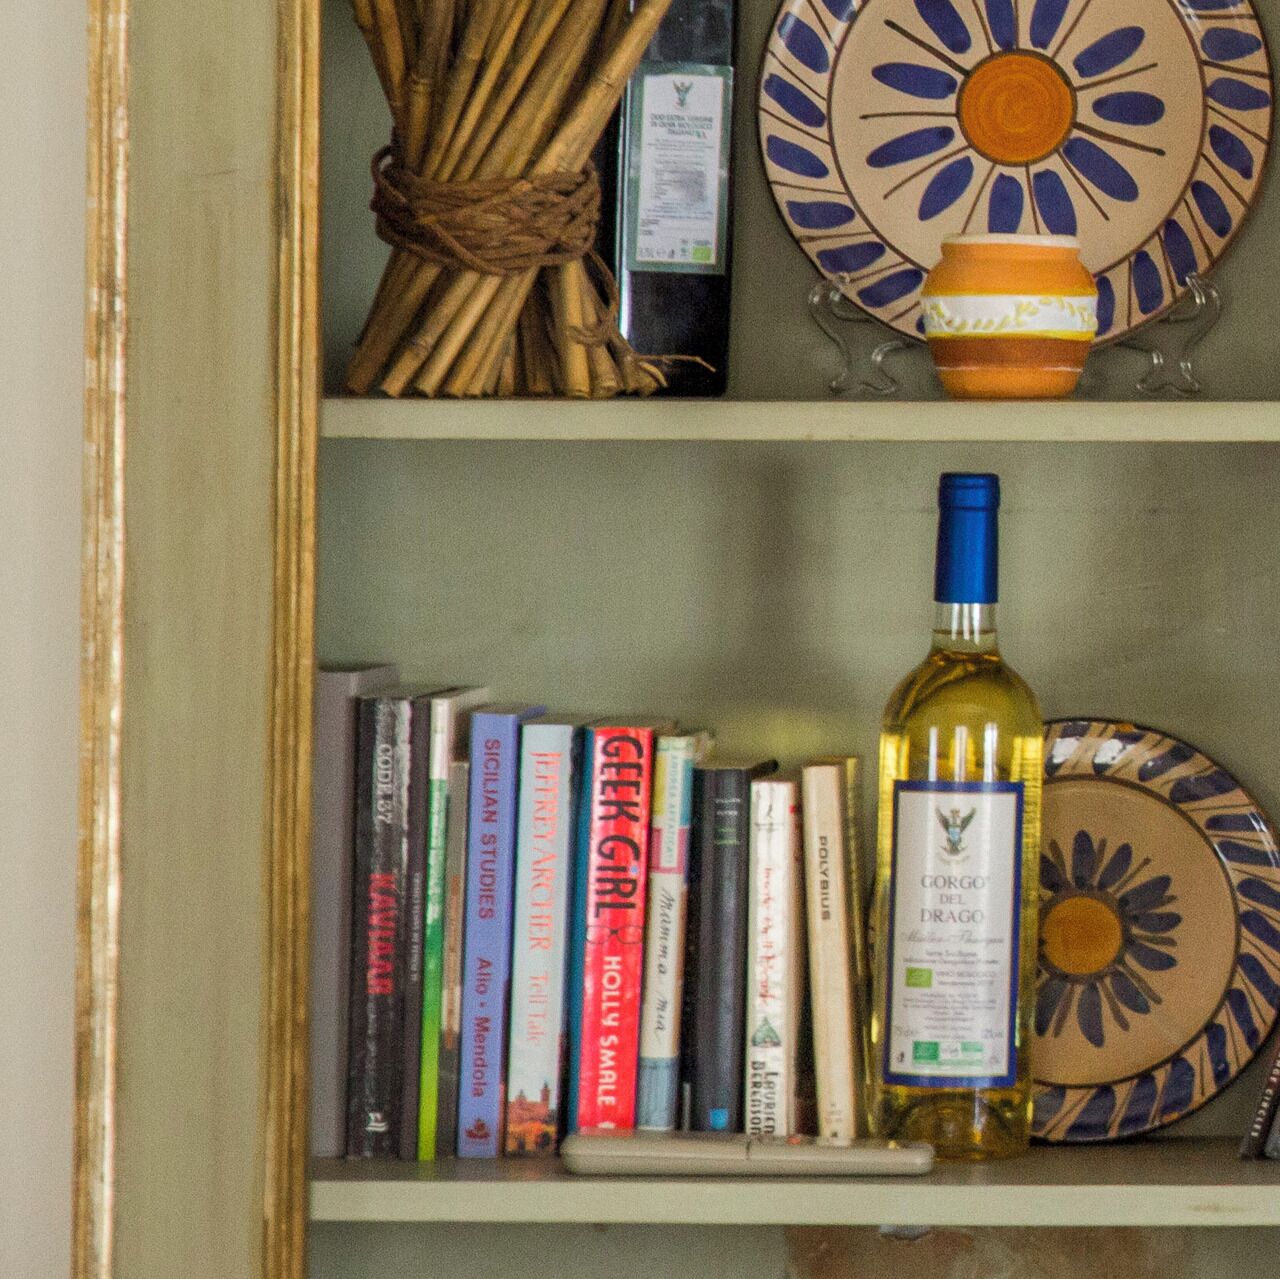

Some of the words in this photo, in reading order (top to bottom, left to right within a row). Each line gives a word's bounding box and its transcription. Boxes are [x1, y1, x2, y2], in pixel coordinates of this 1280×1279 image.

[376, 744, 392, 796] CODE
[480, 739, 501, 822] SICILIAN
[529, 750, 562, 844] JEFFREY
[597, 732, 644, 826] GEEK
[478, 833, 496, 920] STUDIES
[525, 846, 557, 954] ARCHER
[817, 835, 830, 920] POLYBIUS
[921, 874, 986, 890] GORGO
[939, 893, 966, 905] DEL
[920, 907, 985, 924] DRAGO
[528, 968, 550, 1007] Tell
[600, 954, 621, 1028] HOLLY
[471, 1015, 491, 1097] Mendola
[596, 1033, 618, 1106] SMALE
[1249, 1086, 1273, 1138] CIRCLES
